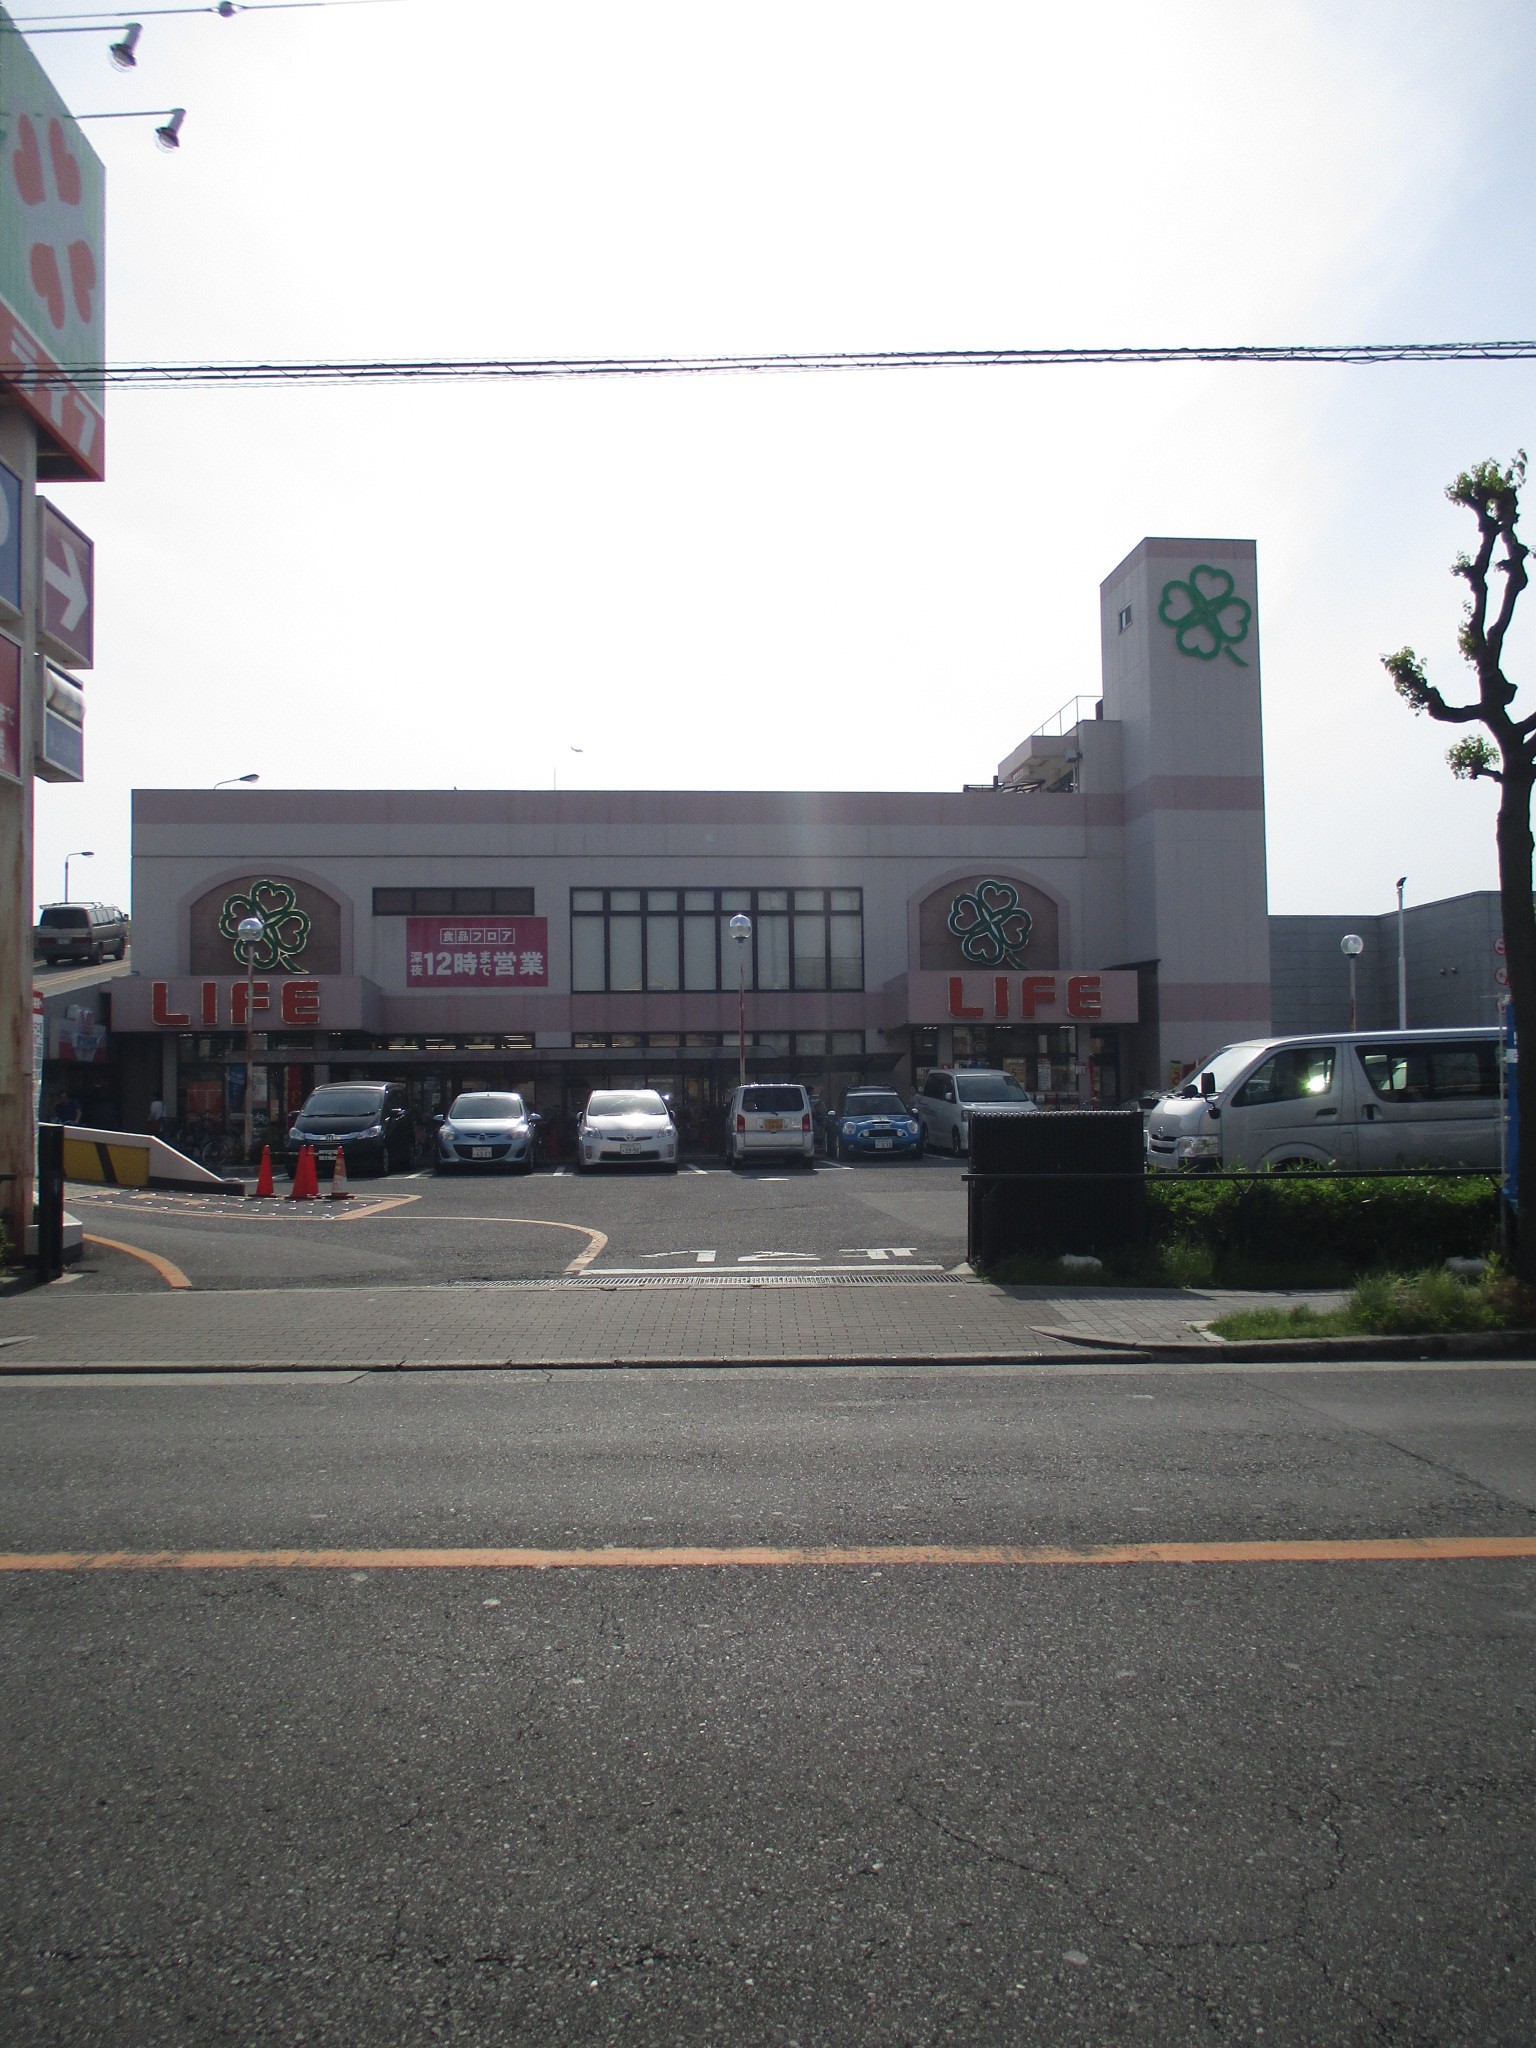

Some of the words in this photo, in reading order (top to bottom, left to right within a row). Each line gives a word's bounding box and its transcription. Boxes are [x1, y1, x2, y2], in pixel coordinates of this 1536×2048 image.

[442, 930, 512, 942] 食品フロア
[151, 980, 320, 1026] LIFE
[950, 975, 1102, 1019] LIFE
